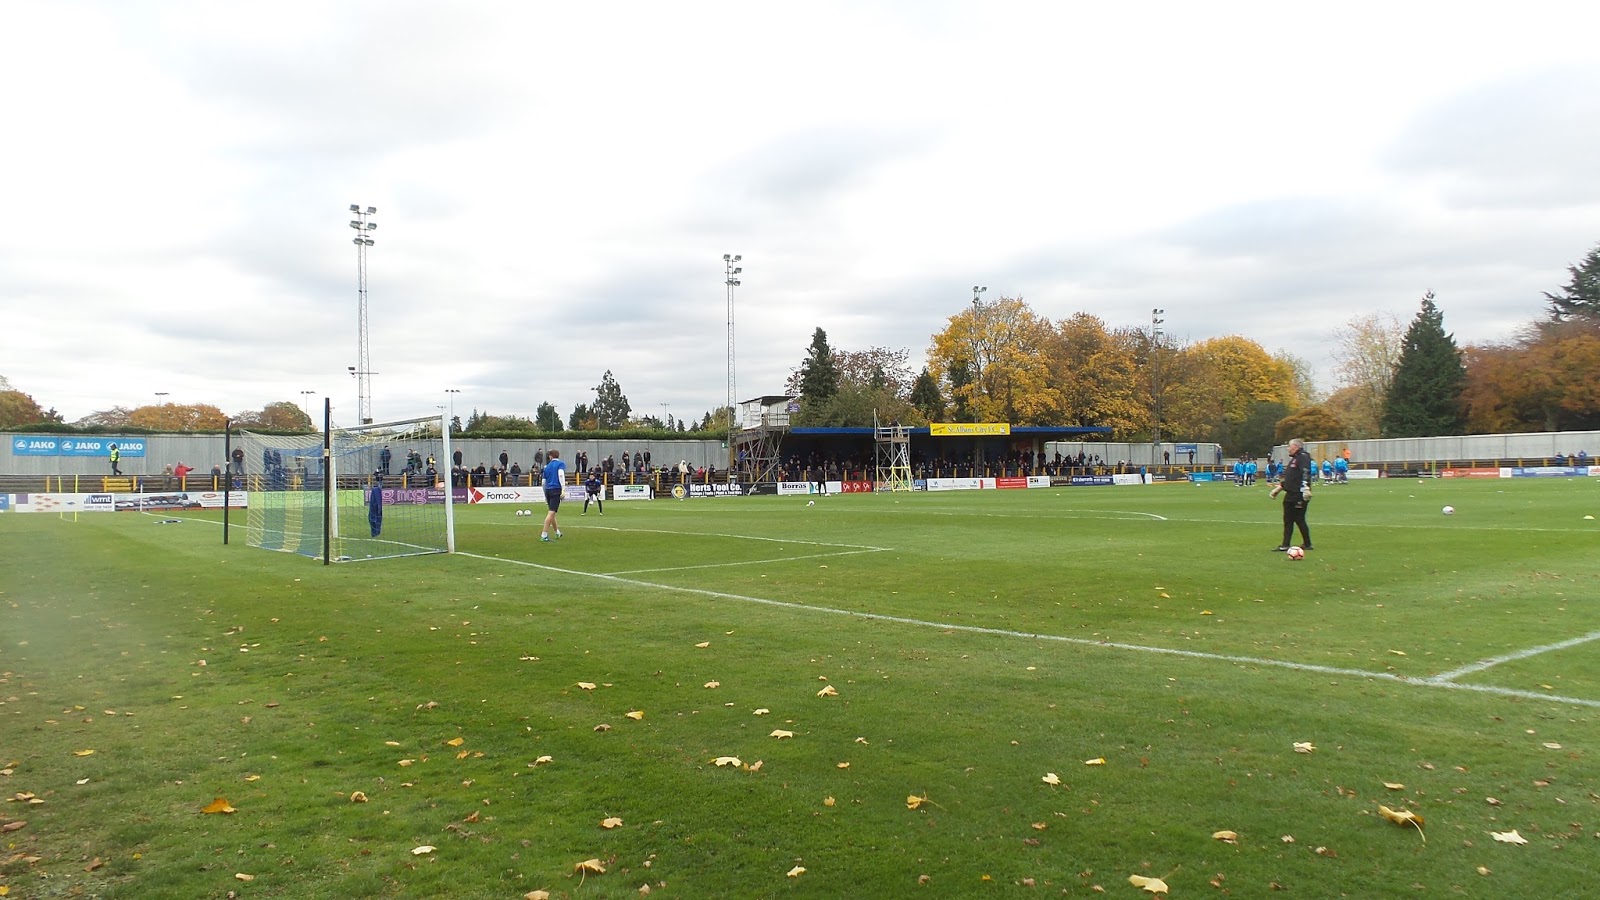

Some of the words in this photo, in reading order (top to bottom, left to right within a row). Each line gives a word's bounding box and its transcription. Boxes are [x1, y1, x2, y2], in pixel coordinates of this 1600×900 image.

[975, 426, 987, 434] City
[29, 441, 56, 449] JAKO
[75, 442, 101, 450] JAKO
[690, 483, 711, 492] Herts
[711, 483, 729, 492] Tool
[730, 483, 742, 491] Co.
[91, 495, 112, 503] wmt
[397, 488, 427, 505] mcg
[486, 491, 515, 500] Fomac
